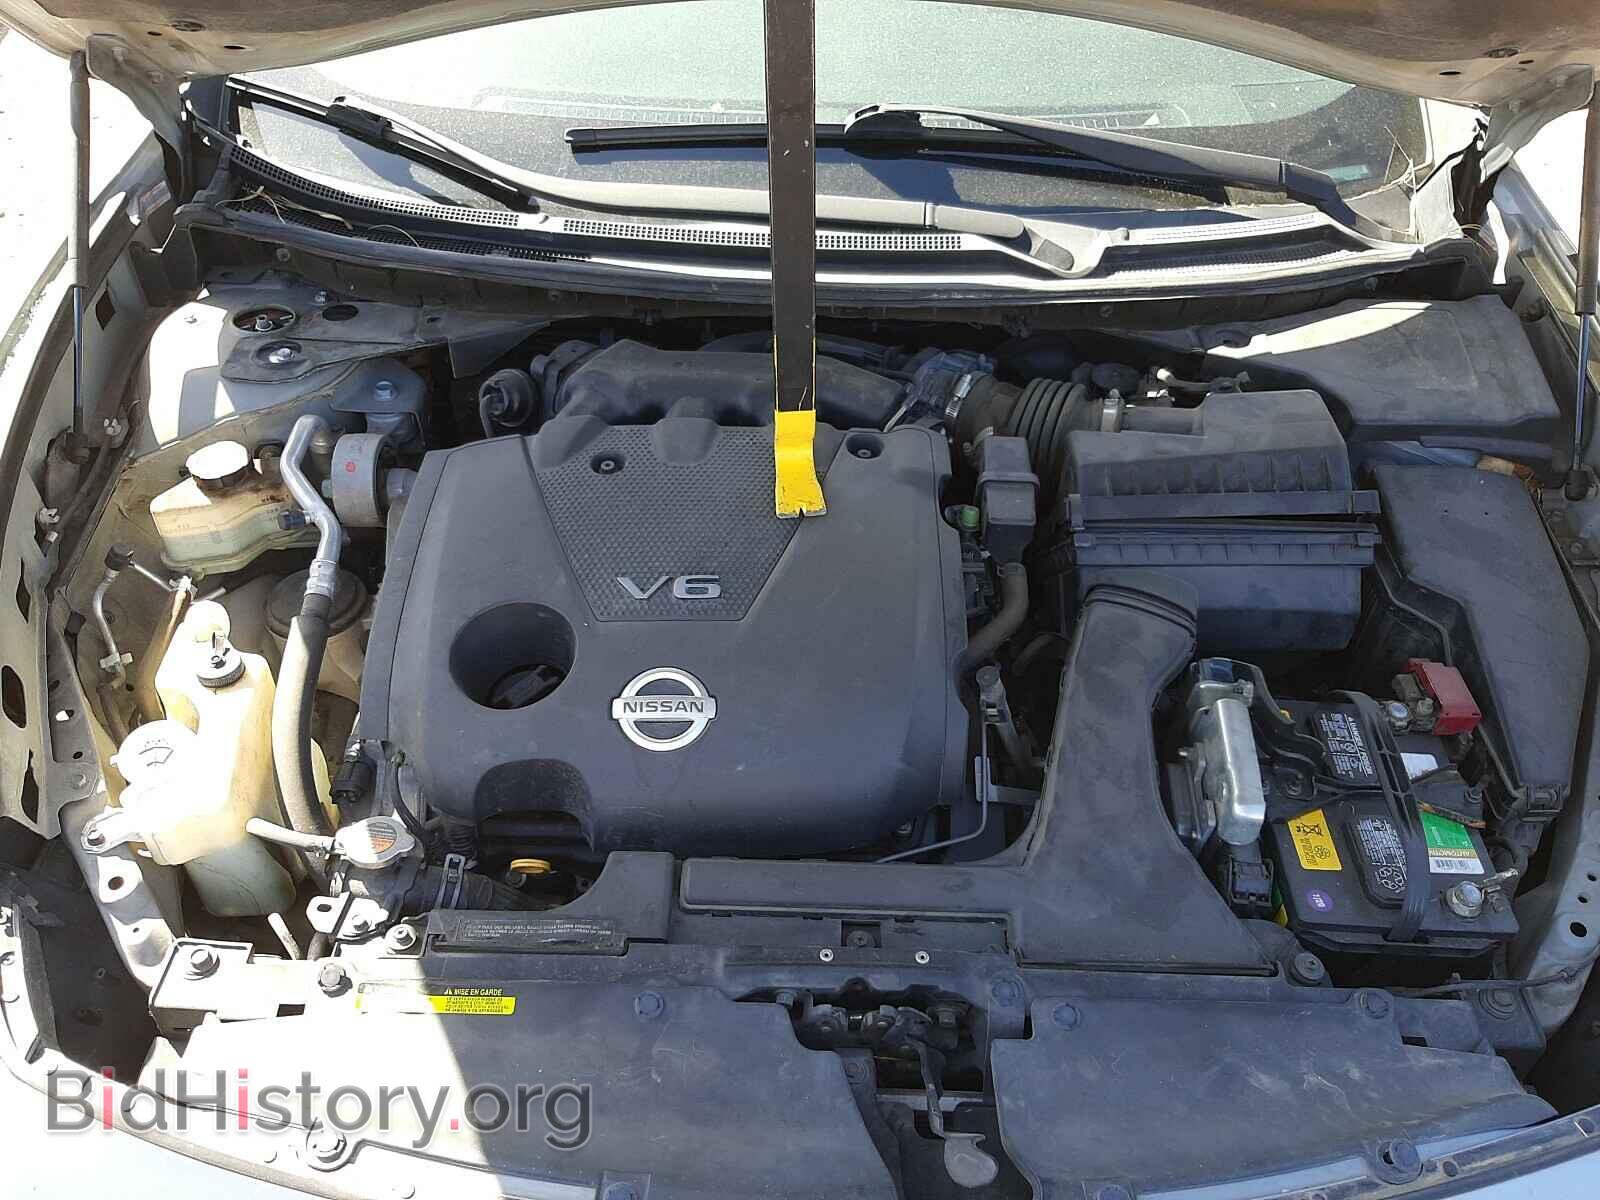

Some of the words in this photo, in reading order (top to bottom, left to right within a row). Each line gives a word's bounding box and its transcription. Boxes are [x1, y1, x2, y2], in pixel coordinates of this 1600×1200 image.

[616, 575, 721, 599] V6
[623, 701, 704, 714] NISSAN
[454, 988, 469, 996] MISE
[469, 988, 479, 996] EN
[480, 988, 503, 996] GARDE
